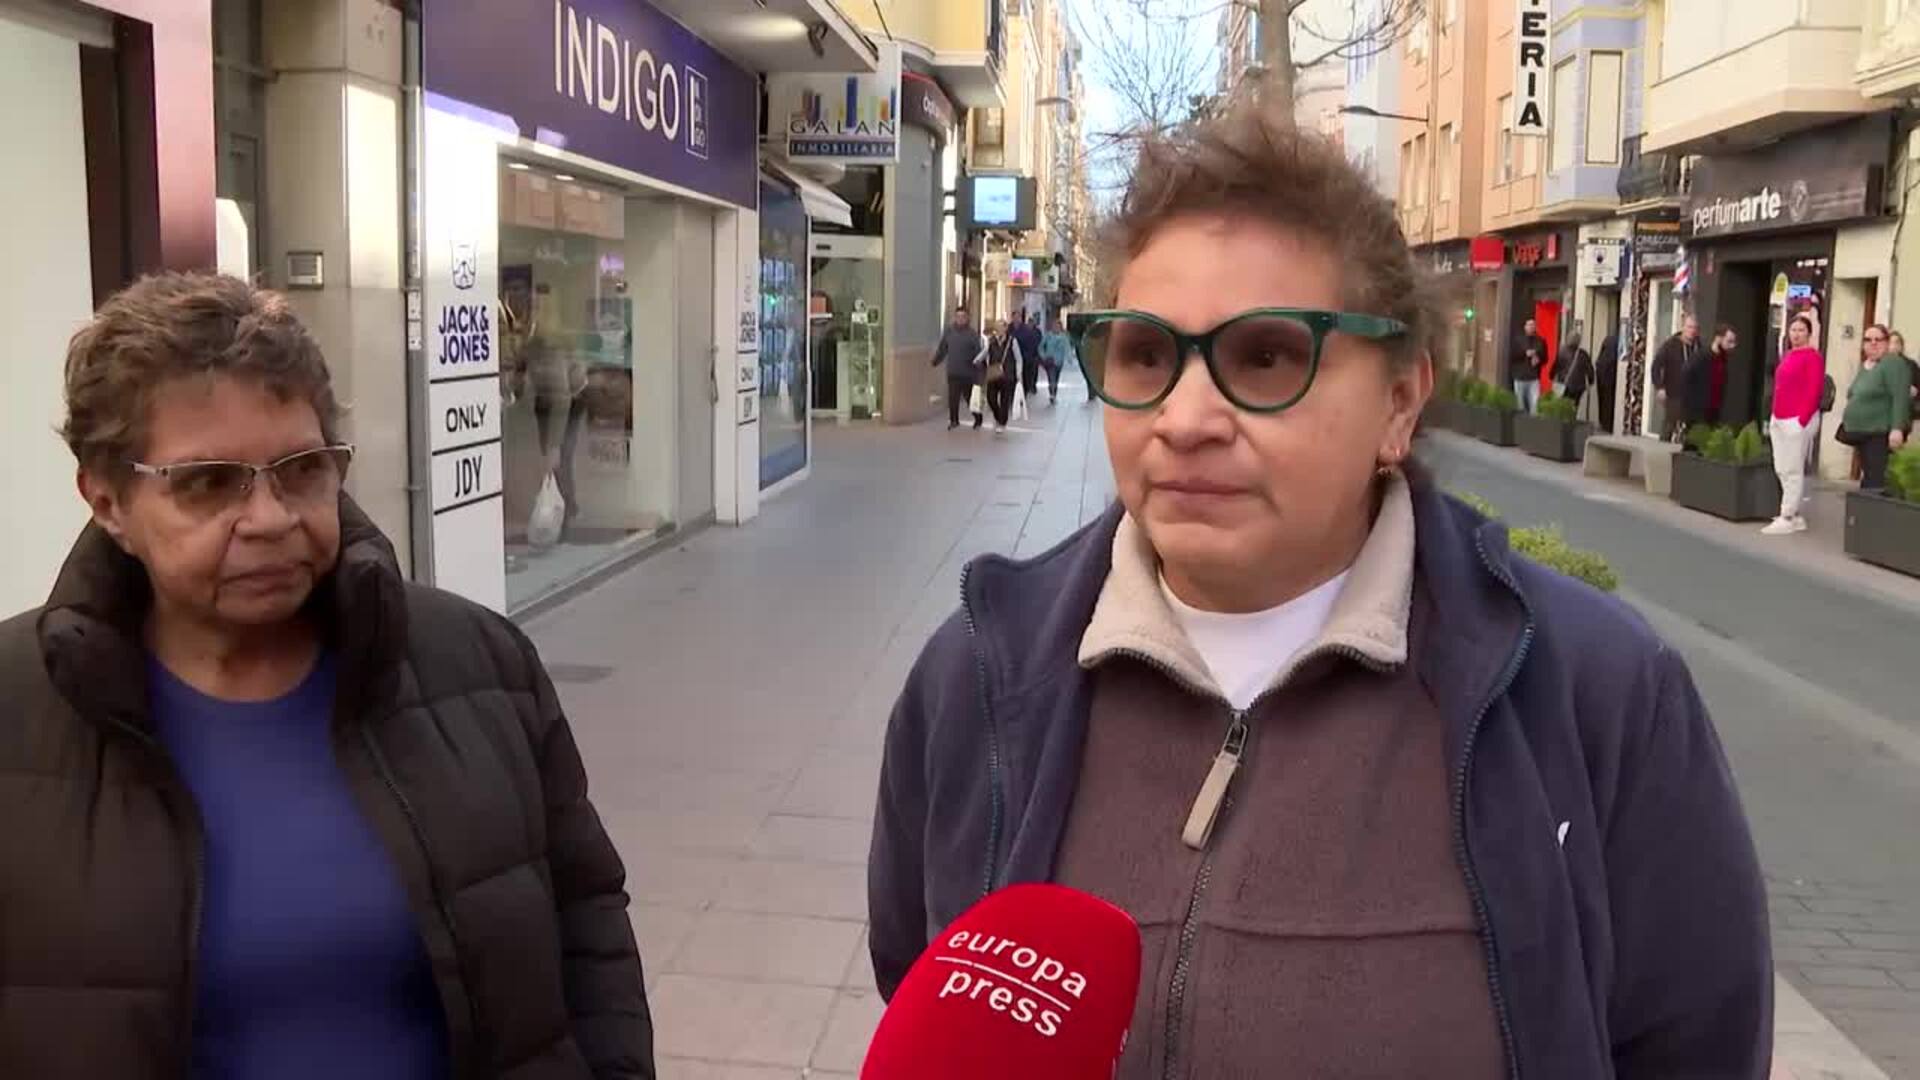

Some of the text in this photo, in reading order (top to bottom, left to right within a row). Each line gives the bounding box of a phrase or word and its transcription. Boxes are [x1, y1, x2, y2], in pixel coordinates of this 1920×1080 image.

[554, 0, 680, 141] INDIGO
[1518, 0, 1547, 127] ERIA
[790, 119, 895, 135] GALAN
[791, 143, 894, 154] INMOBILIARIA
[1692, 186, 1780, 236] perfumarte
[438, 305, 489, 334] JACK&
[438, 333, 490, 364] JONES
[445, 404, 487, 433] ONLY
[454, 455, 482, 498] JDY
[947, 930, 1087, 999] europa
[938, 971, 1062, 1036] press
